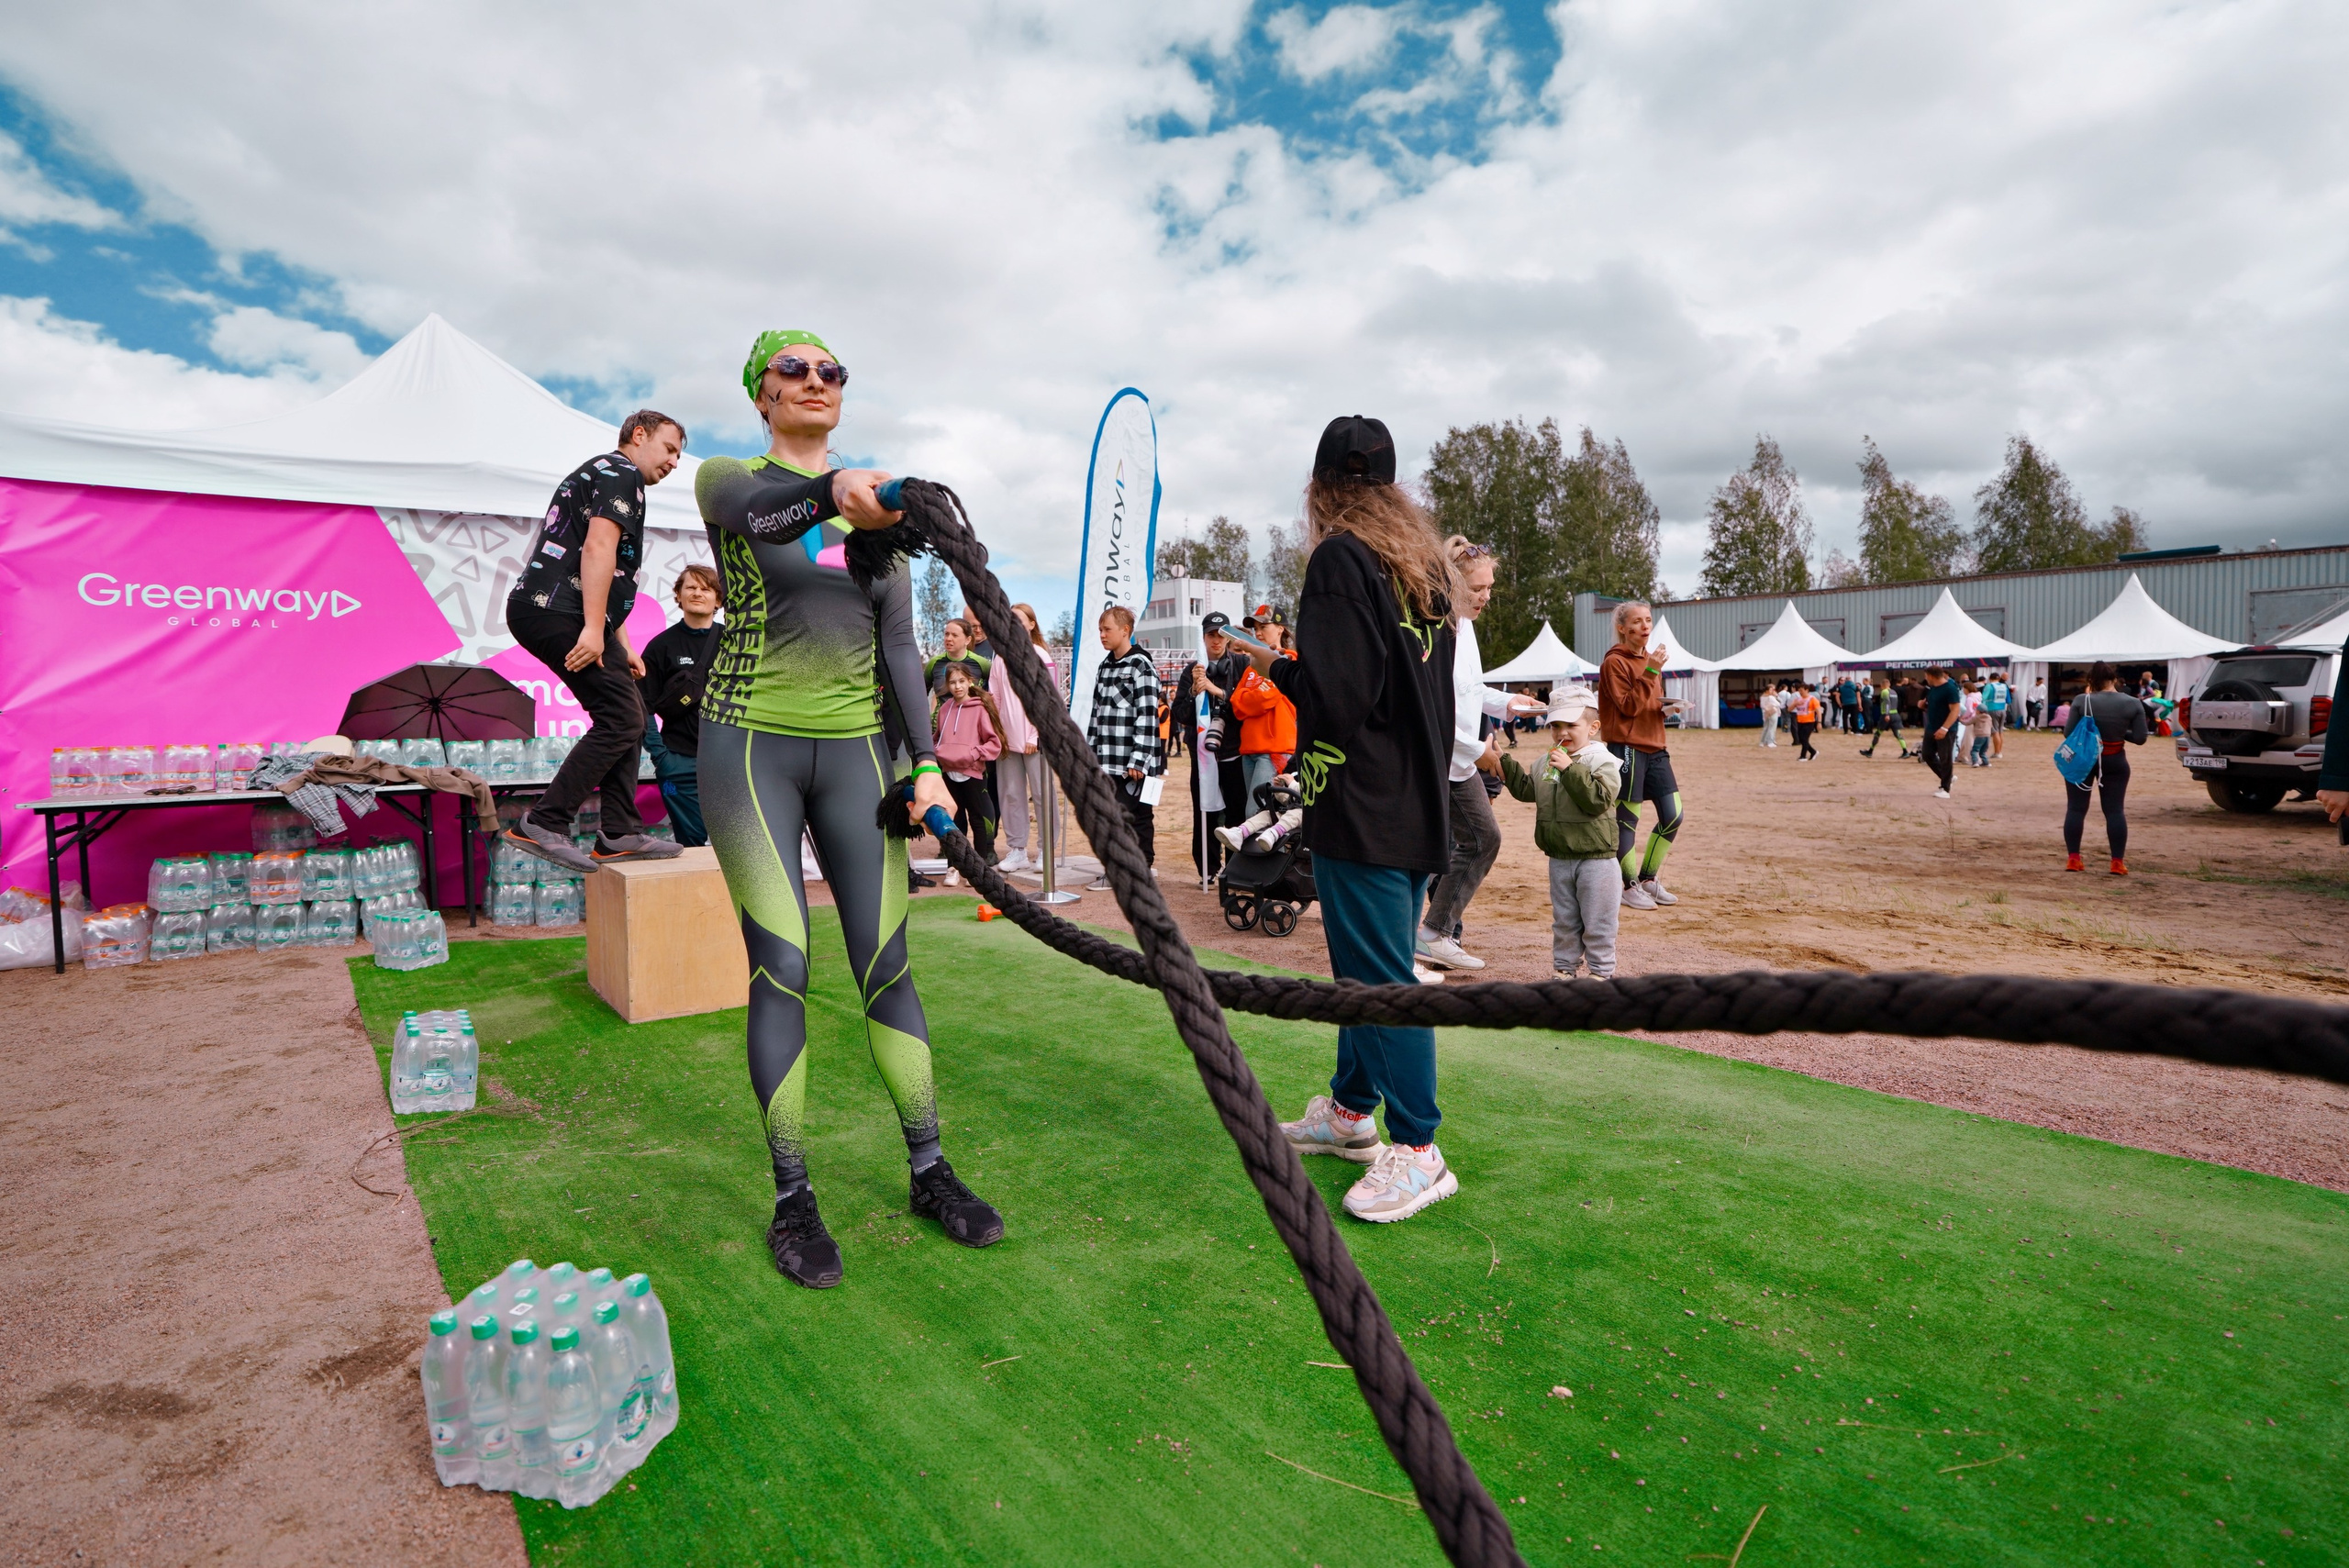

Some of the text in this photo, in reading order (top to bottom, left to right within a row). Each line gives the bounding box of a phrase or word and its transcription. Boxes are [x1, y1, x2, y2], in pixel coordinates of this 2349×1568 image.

[747, 500, 809, 533] Greenway
[77, 572, 328, 621] Greenway
[167, 616, 279, 628] GLOBAL
[1886, 661, 1954, 669] РЕГИСТРАЦИЯ
[2195, 710, 2251, 720] TANK
